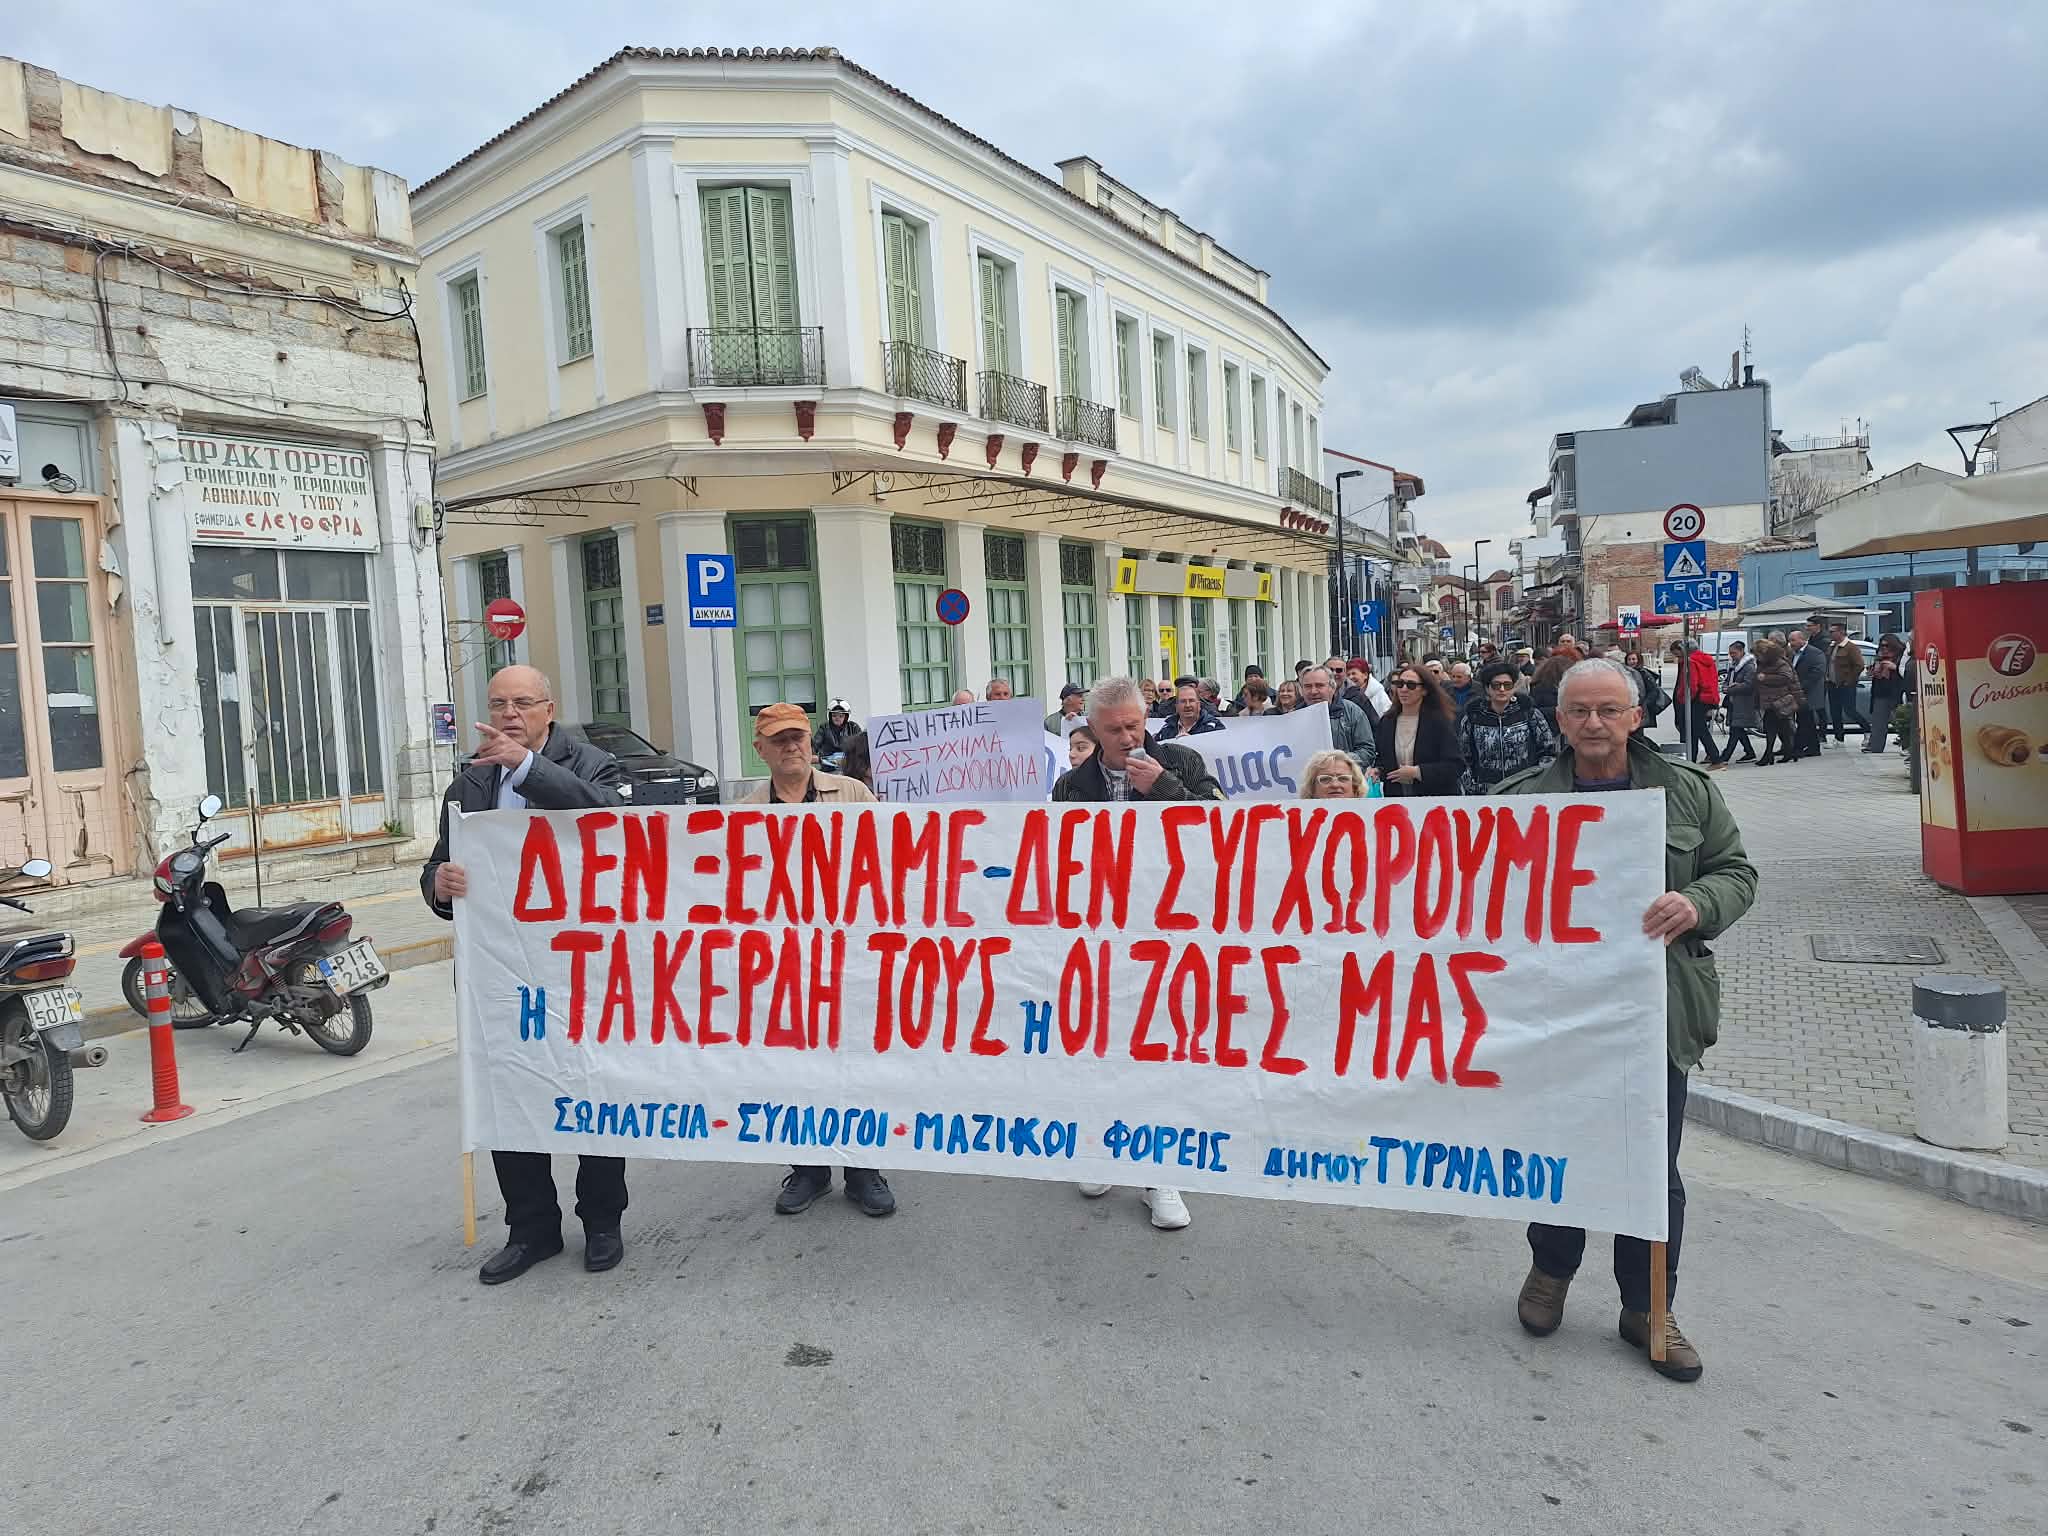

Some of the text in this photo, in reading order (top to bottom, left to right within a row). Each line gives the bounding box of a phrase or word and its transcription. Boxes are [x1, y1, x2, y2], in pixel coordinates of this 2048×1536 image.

[300, 493, 344, 512] ΤΥΠΟΥ
[194, 512, 241, 527] ΕΦΗΜΕΡΙΔΑ
[1672, 515, 1696, 531] 20
[698, 558, 726, 596] P
[695, 608, 732, 619] ΔΙΚΥΚΛΑ
[1359, 604, 1371, 621] P
[1924, 678, 1946, 697] mini
[875, 705, 997, 749] ΔΕΝ ΗΤΑΝΕ
[877, 768, 930, 802] ΗΤΑΝ
[512, 810, 670, 925] ΔΕΝ
[1153, 803, 1605, 945] ΣΥΓΧΩΡΟΥΜΕ
[34, 1005, 67, 1027] 507
[550, 929, 637, 1046] ΤΑ
[650, 926, 845, 1052] ΚΕΡΔΗ
[866, 931, 1012, 1056] ΤΟΥΣ
[1058, 936, 1112, 1059] ΟΙ
[1129, 938, 1308, 1076] ΖΩΕΣ
[1334, 949, 1508, 1088] ΜΑΣ
[1103, 1119, 1231, 1174] ΦΟΡΕΙΣ
[1262, 1146, 1370, 1187] ΔΗΜΟΥ
[1368, 1134, 1568, 1204] ΤΥΡΝΑΒΟΥ
